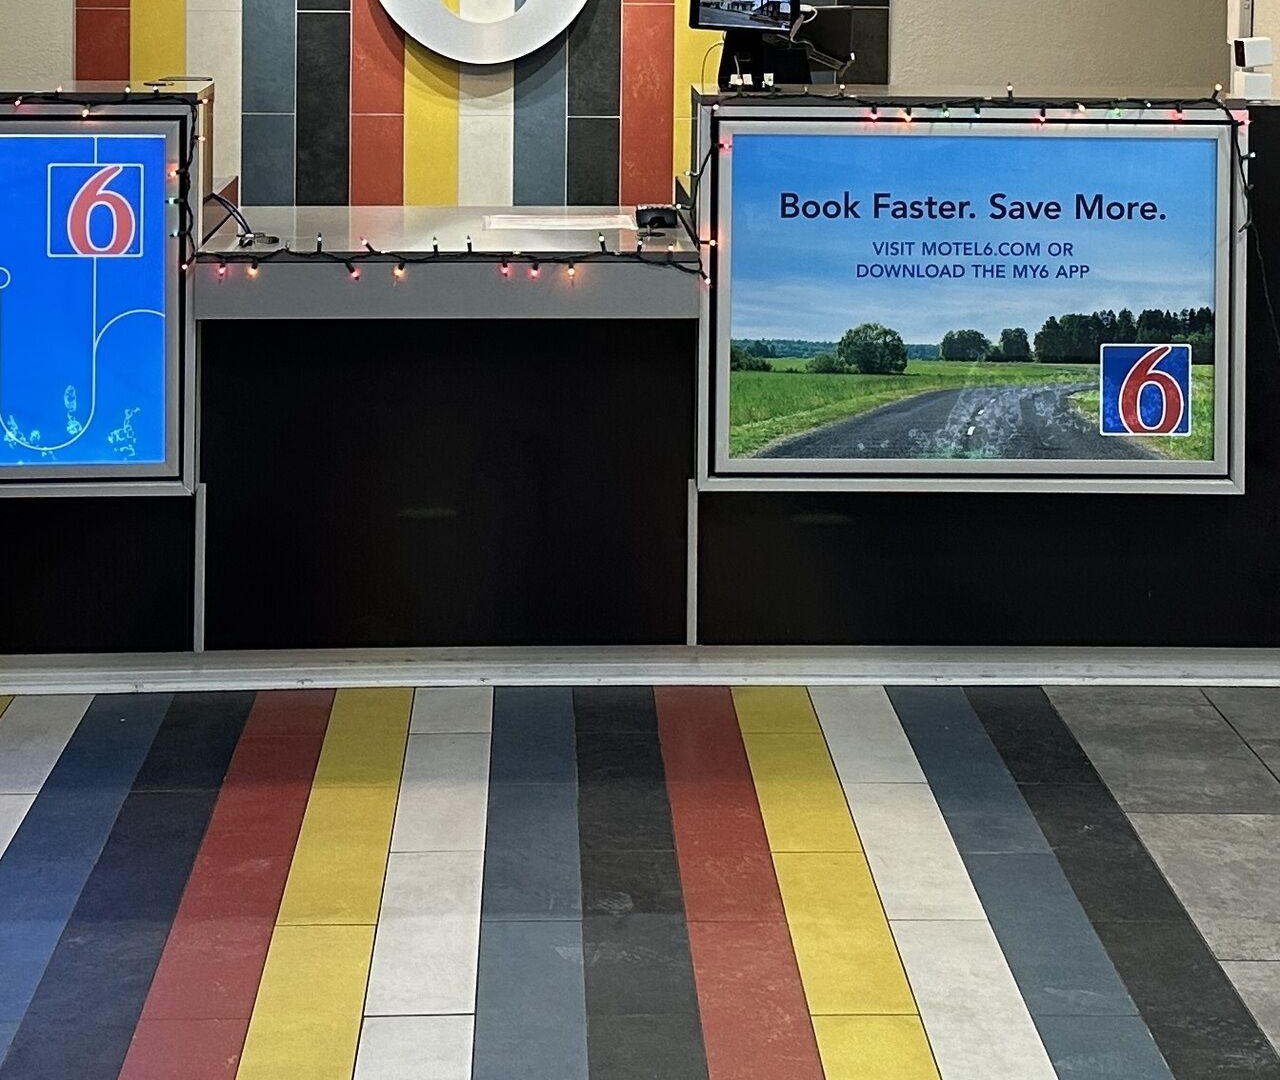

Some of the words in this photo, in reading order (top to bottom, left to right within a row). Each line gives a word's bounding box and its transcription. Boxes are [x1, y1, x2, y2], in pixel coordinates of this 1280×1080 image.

[66, 164, 136, 257] 6
[780, 191, 861, 220] Book
[873, 192, 976, 220] Faster.
[989, 192, 1062, 221] Save
[1075, 193, 1167, 221] More.
[872, 241, 915, 256] VISIT
[922, 241, 1041, 257] MOTEL6.COM
[1047, 241, 1074, 257] OR
[856, 263, 966, 279] DOWNLOAD
[972, 264, 1006, 279] THE
[1012, 264, 1049, 279] MY6
[1055, 264, 1090, 279] APP
[1118, 345, 1185, 435] 6
